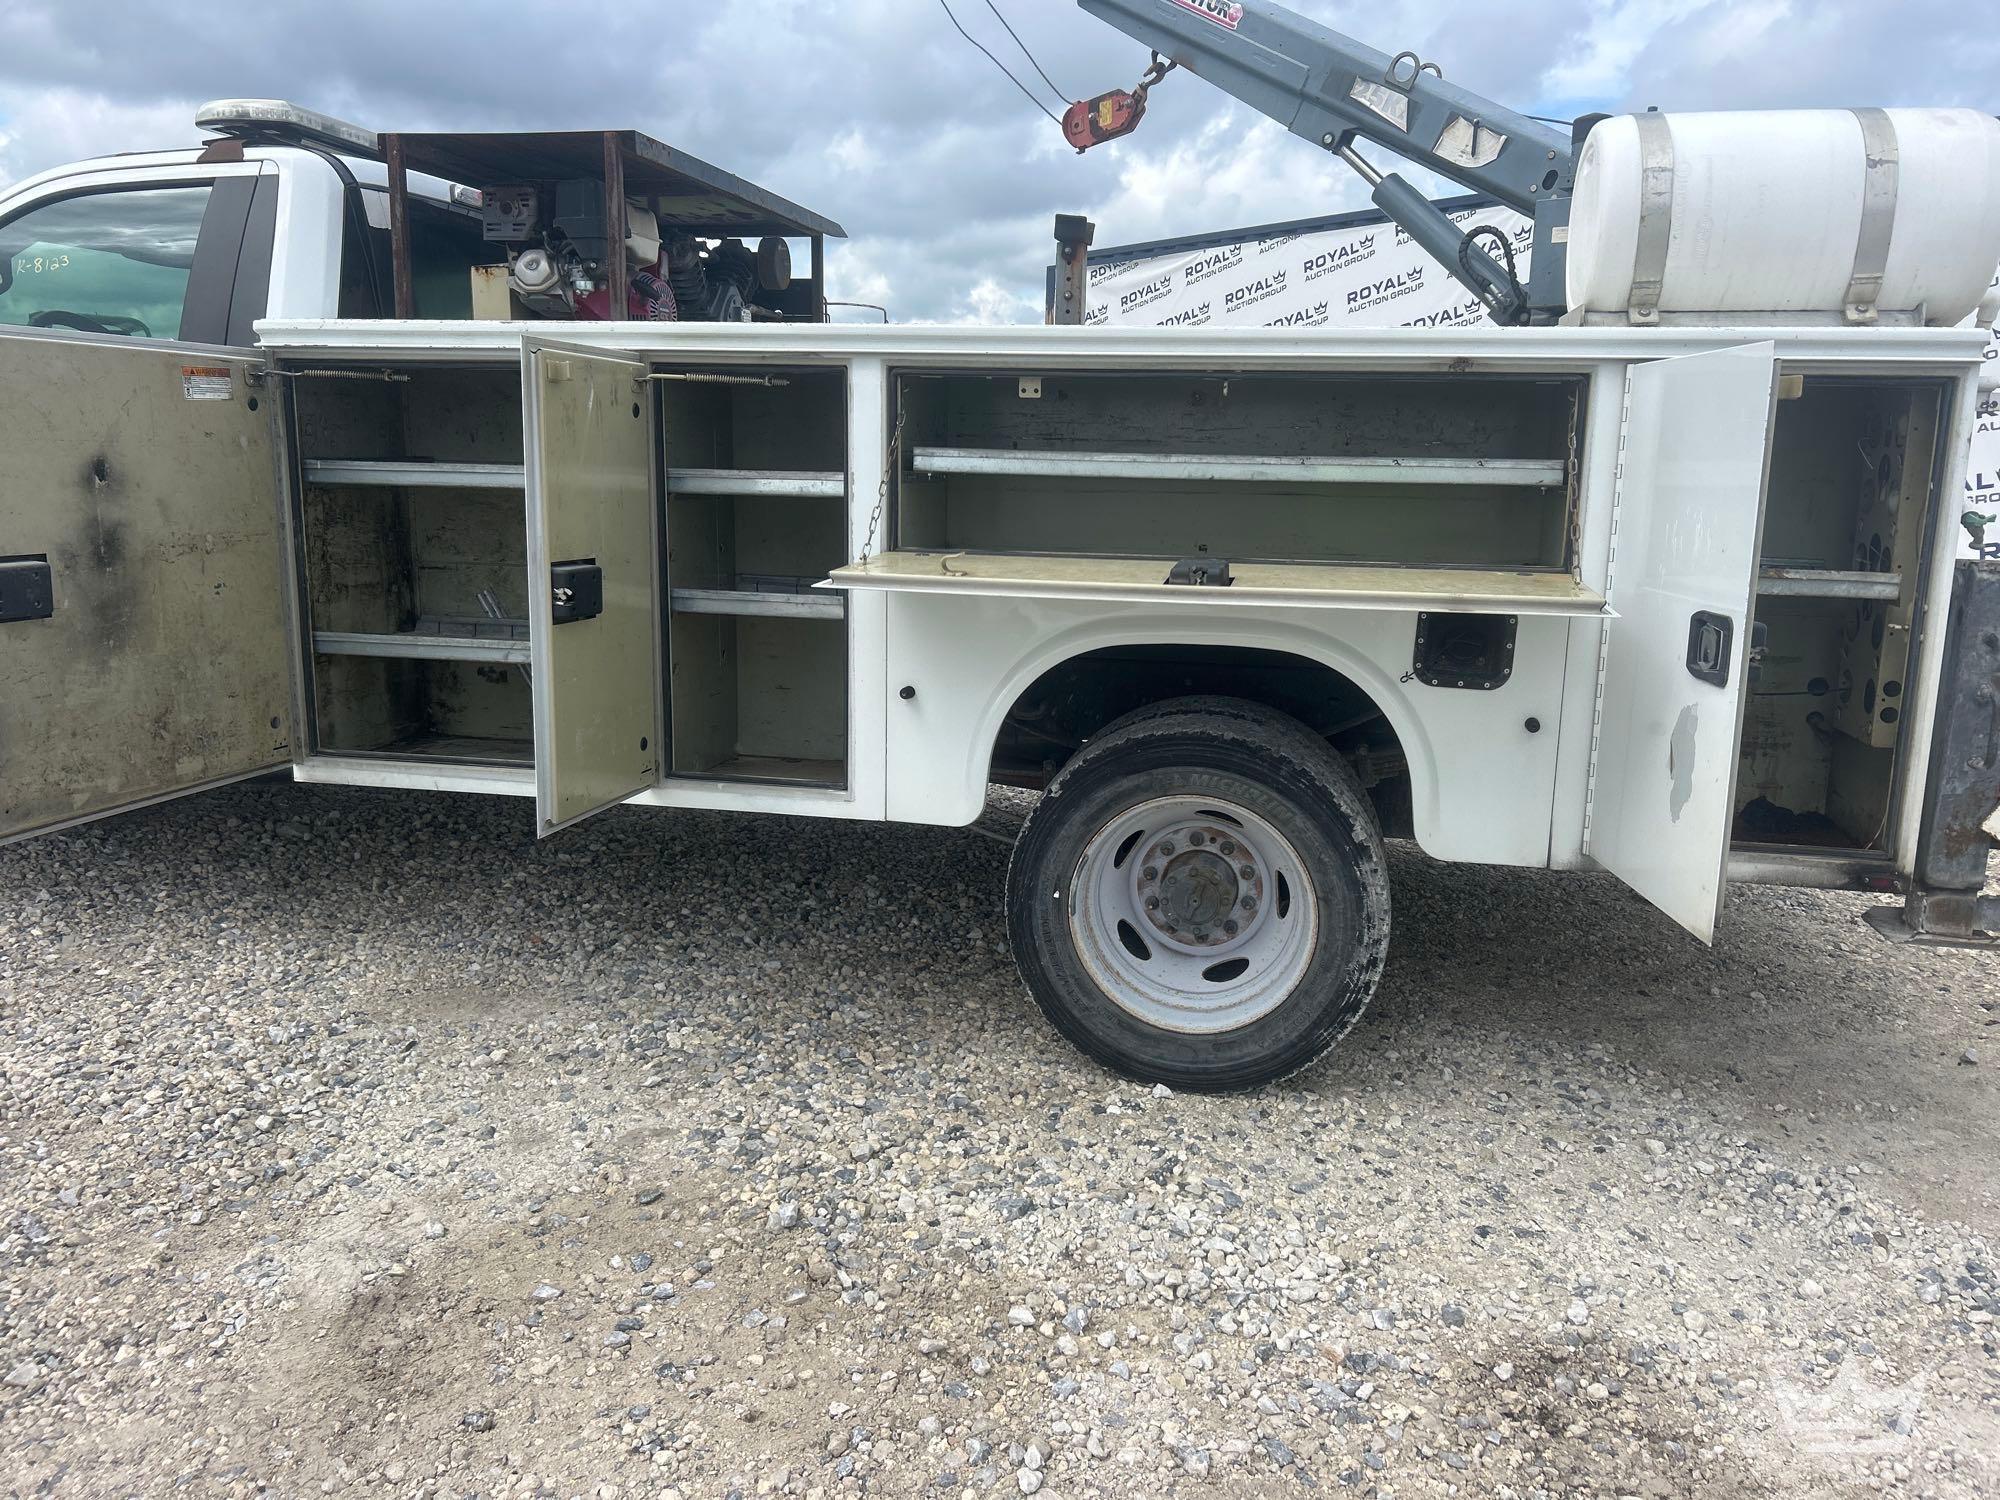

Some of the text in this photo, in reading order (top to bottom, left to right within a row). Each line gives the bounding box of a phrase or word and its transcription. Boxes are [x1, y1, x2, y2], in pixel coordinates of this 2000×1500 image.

[1450, 209, 1477, 224] OUP
[1185, 250, 1230, 279] ROYAL
[1303, 242, 1360, 273] ROYAL
[1304, 249, 1376, 282] AUCTION GROUP
[1494, 242, 1533, 262] GOUP
[1091, 262, 1139, 288] AUCTION GROUP
[1185, 257, 1243, 287] AUCTION GROUP
[1120, 282, 1161, 307] ROYAL
[1121, 288, 1172, 315] AUCTION GROUP
[1225, 277, 1273, 306] ROYAL
[1226, 284, 1287, 314] AUCTION GROUP
[1346, 274, 1407, 305] ROYAL
[1347, 282, 1424, 314] AUCTION GROUP
[1263, 308, 1314, 327] OYAL
